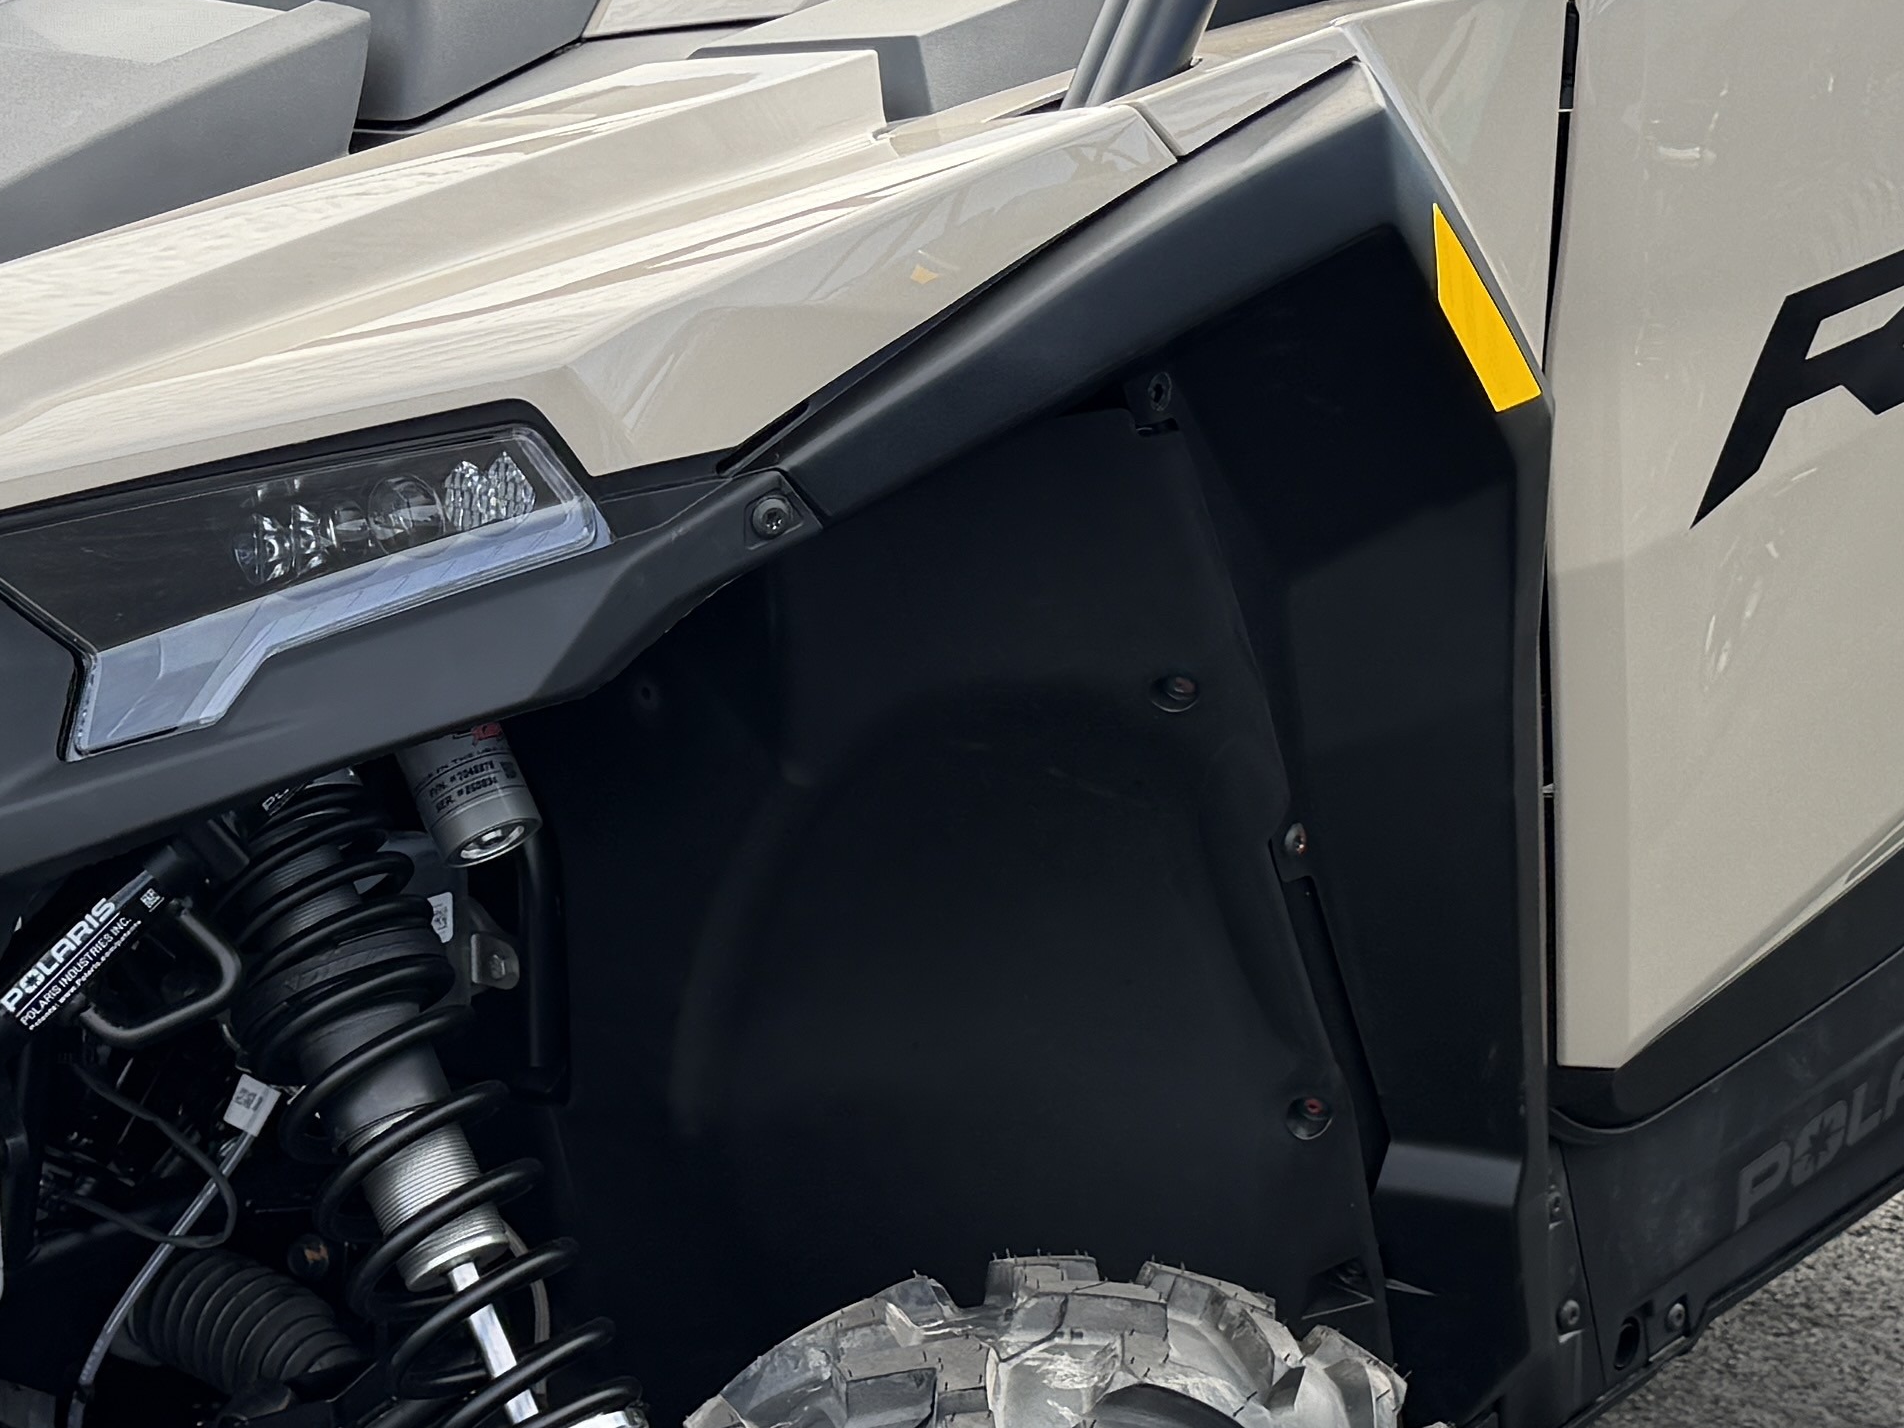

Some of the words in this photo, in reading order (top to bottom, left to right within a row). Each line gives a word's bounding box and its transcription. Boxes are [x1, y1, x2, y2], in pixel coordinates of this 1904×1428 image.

[0, 897, 116, 1013] POLARIS
[19, 985, 62, 1026] POLARIS
[58, 934, 114, 988] INDUSTRIES
[110, 917, 132, 940] INC.
